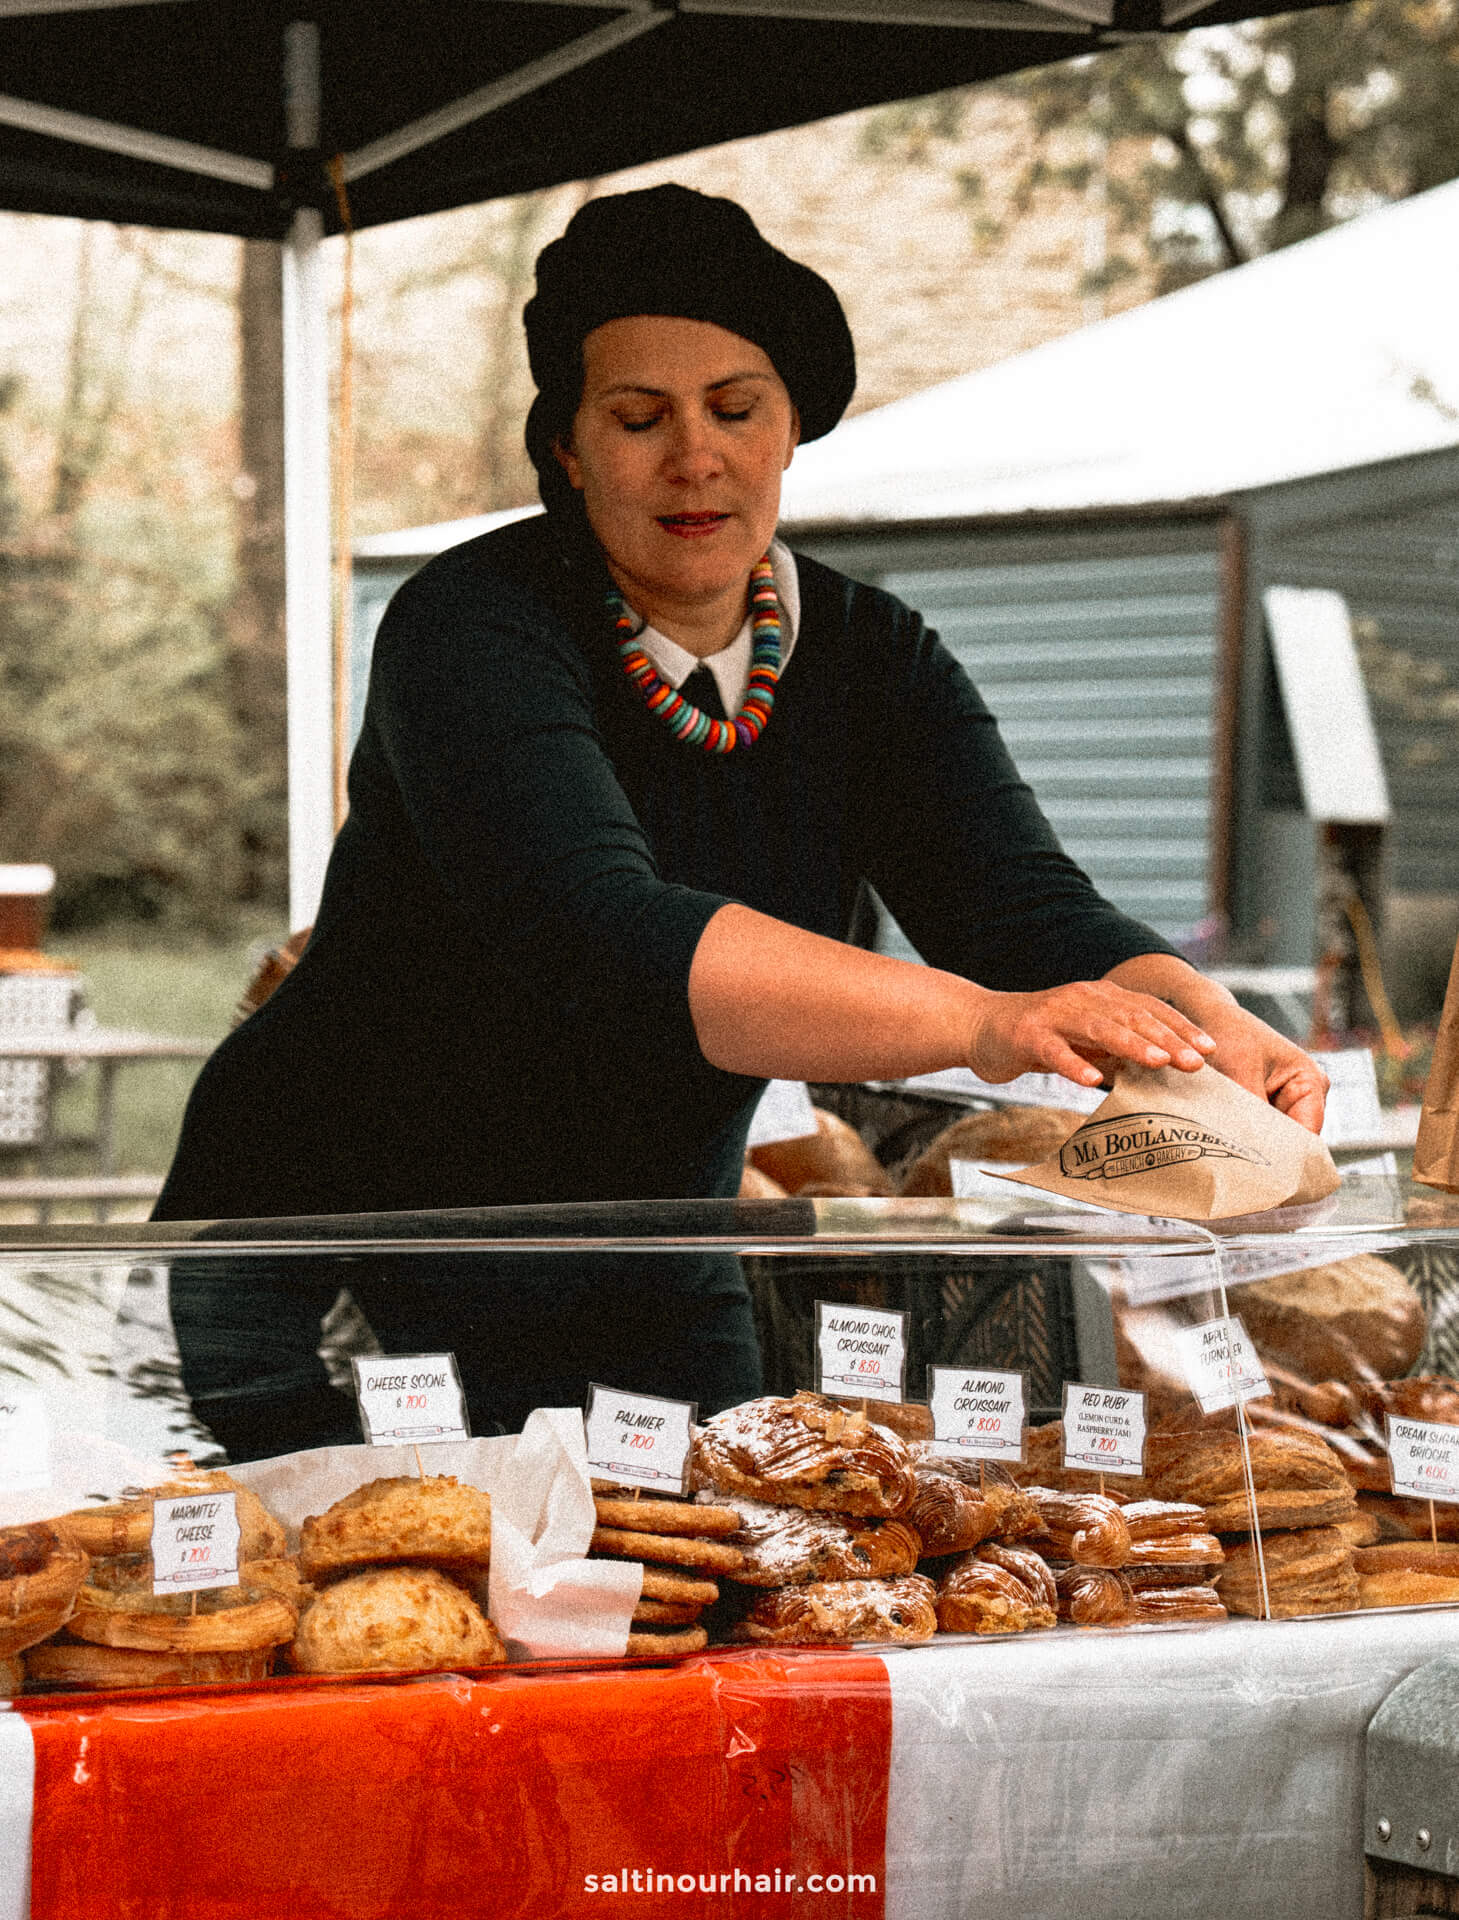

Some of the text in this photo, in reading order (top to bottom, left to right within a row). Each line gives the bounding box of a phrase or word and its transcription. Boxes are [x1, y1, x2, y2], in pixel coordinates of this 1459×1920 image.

[1072, 1128, 1248, 1166] MA BOULANGE
[1115, 1147, 1186, 1173] FRENCH BAKERY
[828, 1318, 896, 1340] ALMOND CHOC.
[1202, 1327, 1229, 1346] APPLE
[837, 1338, 890, 1357] CROISSANT
[1200, 1342, 1243, 1366] TURNOER
[366, 1372, 448, 1391] CHEESE SCONE
[961, 1379, 1005, 1394] ALMOND
[953, 1397, 1012, 1413] CROISSANT
[1082, 1392, 1130, 1410] RED RUBY
[615, 1410, 666, 1431] PALMIER
[1078, 1412, 1104, 1423] (LEMON
[1104, 1415, 1123, 1426] CURD
[1077, 1423, 1132, 1439] RASPBERRY JAM)
[1395, 1425, 1427, 1441] CREAM
[1409, 1445, 1453, 1463] BRIOCHE
[176, 1524, 216, 1543] CHEESE
